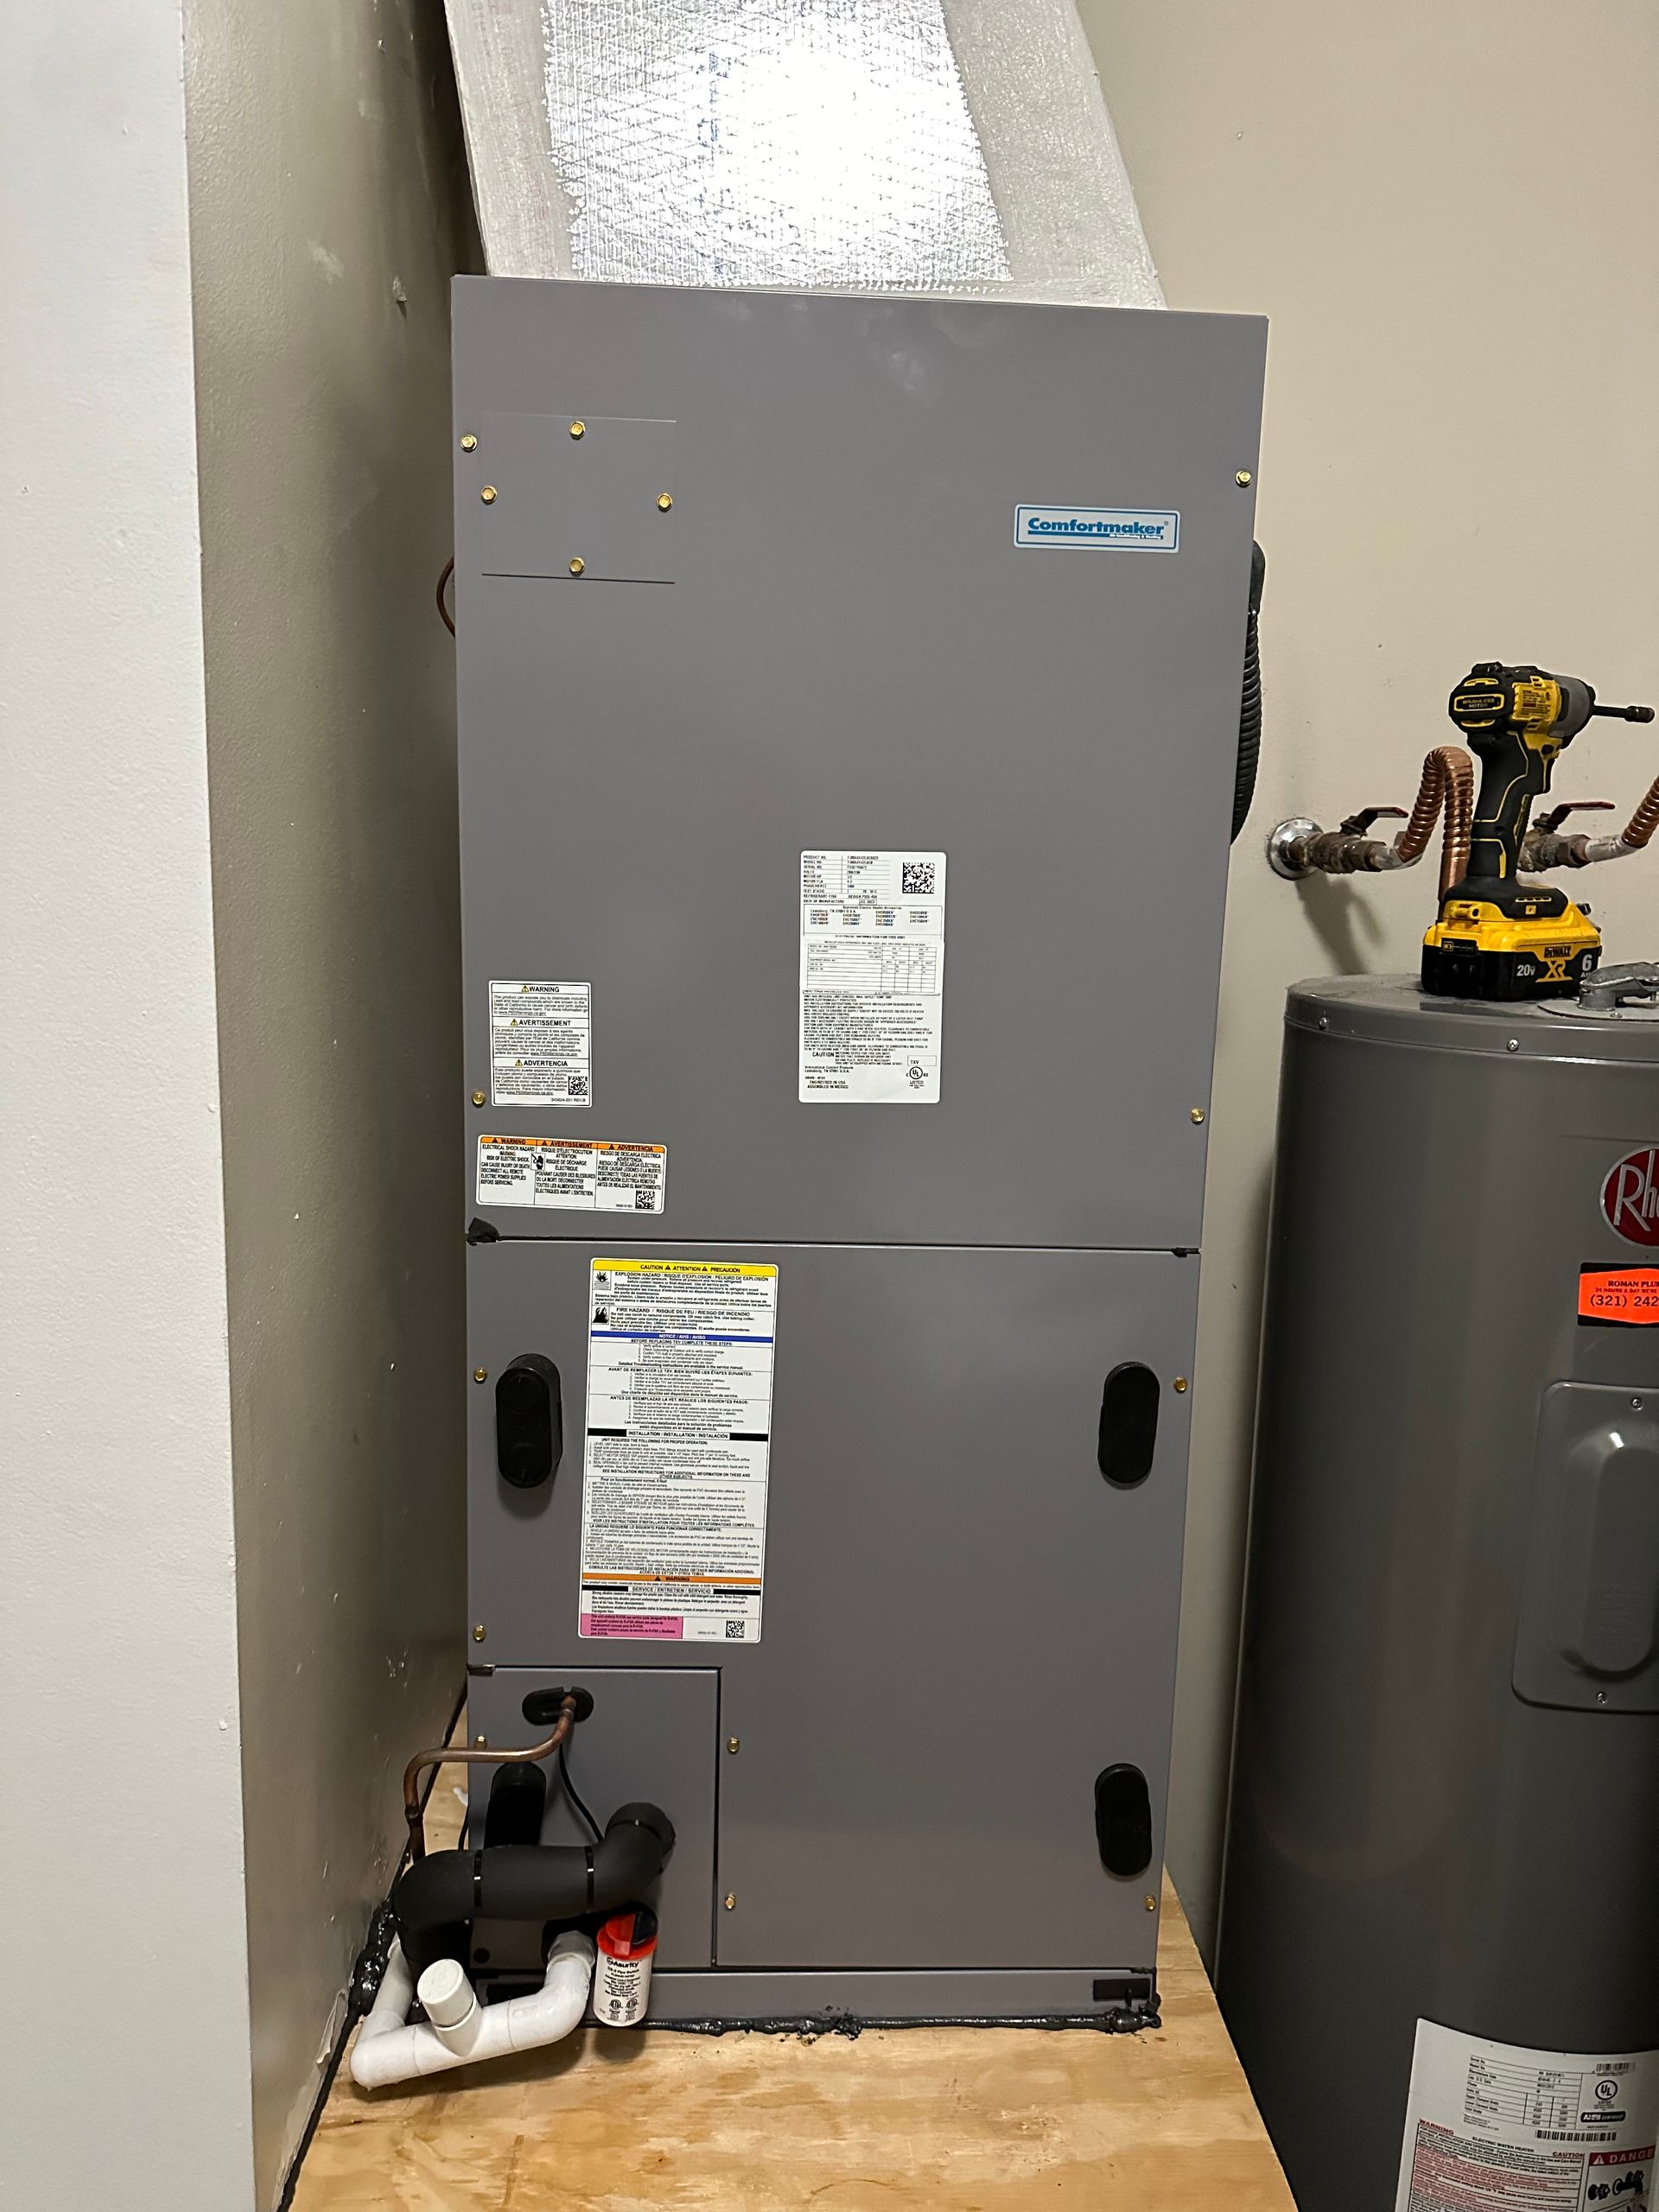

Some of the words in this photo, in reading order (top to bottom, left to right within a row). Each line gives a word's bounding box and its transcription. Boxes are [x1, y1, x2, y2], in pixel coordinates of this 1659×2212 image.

[1028, 517, 1164, 535] Comfortmaker
[1582, 954, 1592, 971] 6
[1539, 960, 1570, 983] XR
[1613, 1150, 1659, 1231] Rh
[1590, 1294, 1627, 1307] (321)
[1600, 2085, 1612, 2095] UL
[1419, 2118, 1454, 2135] WARNING
[1471, 2135, 1497, 2145] ELECTRIC
[1515, 2144, 1535, 2153] HEATER
